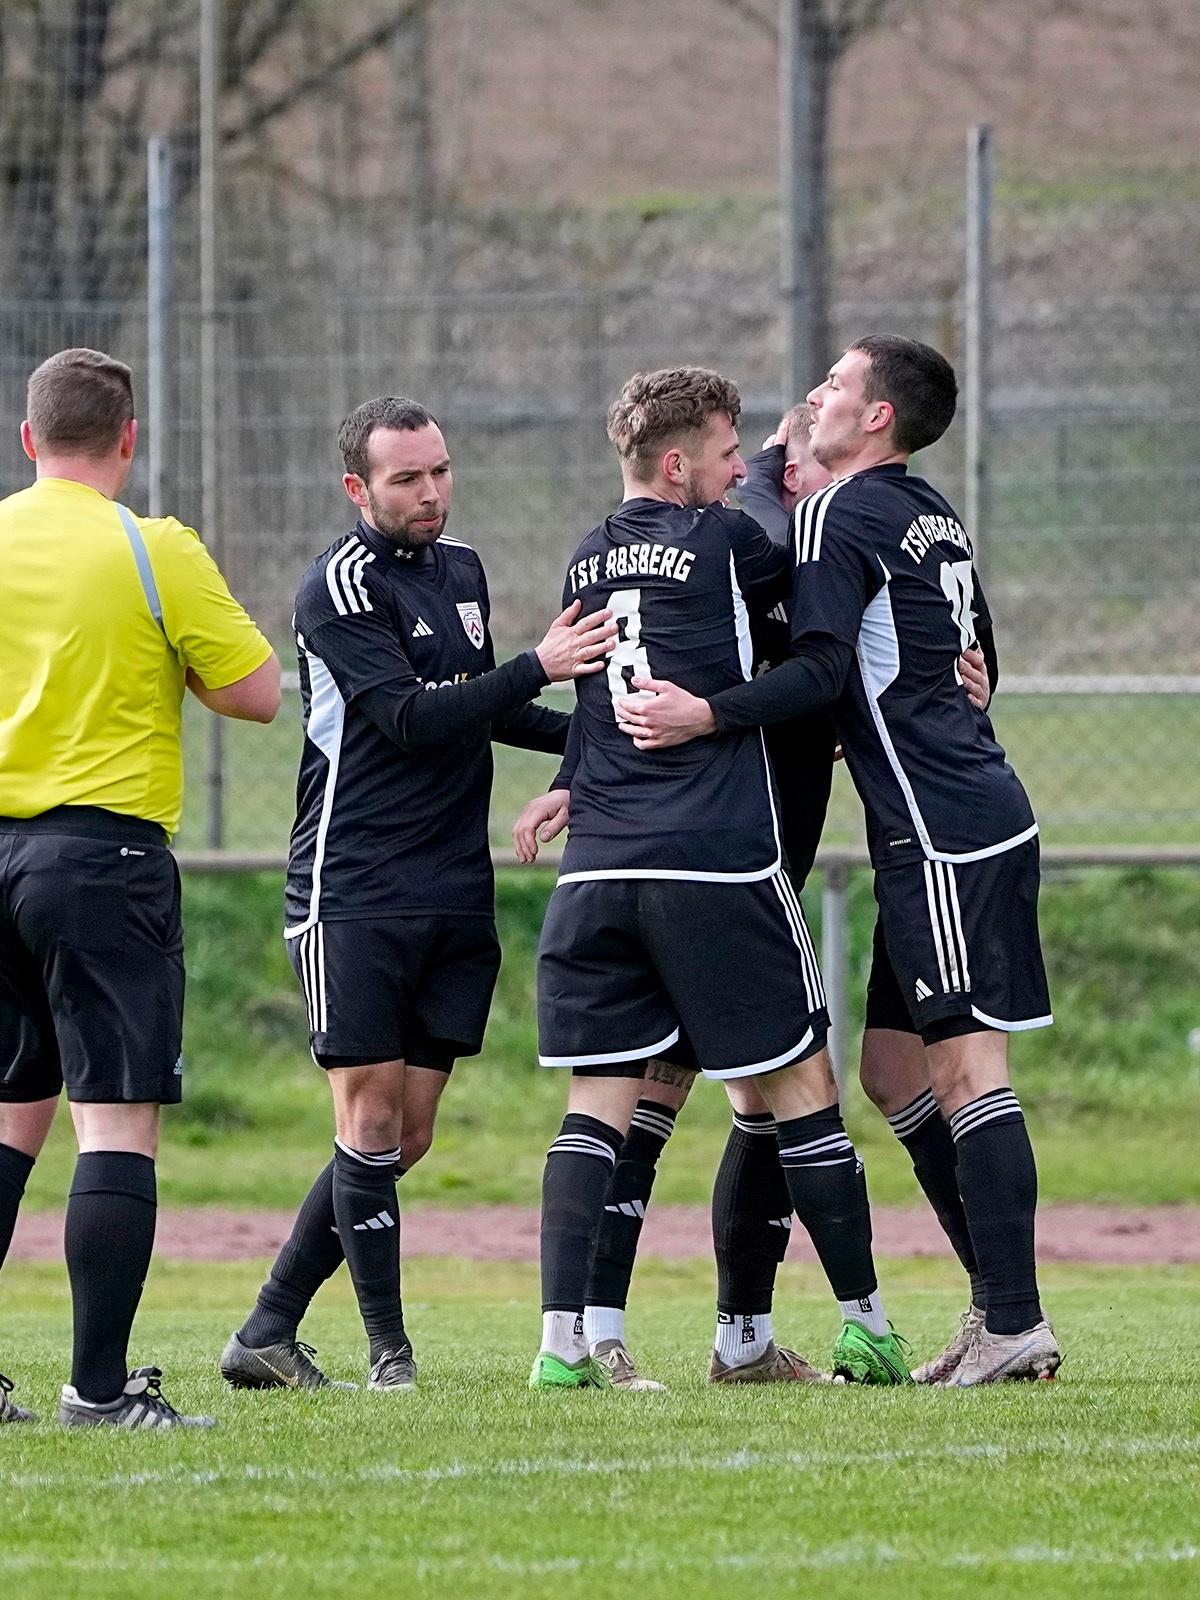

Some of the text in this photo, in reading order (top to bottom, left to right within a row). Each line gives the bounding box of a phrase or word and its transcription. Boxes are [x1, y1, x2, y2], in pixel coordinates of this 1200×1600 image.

[569, 543, 697, 594] TSV ABSBERG
[603, 588, 657, 723] 8
